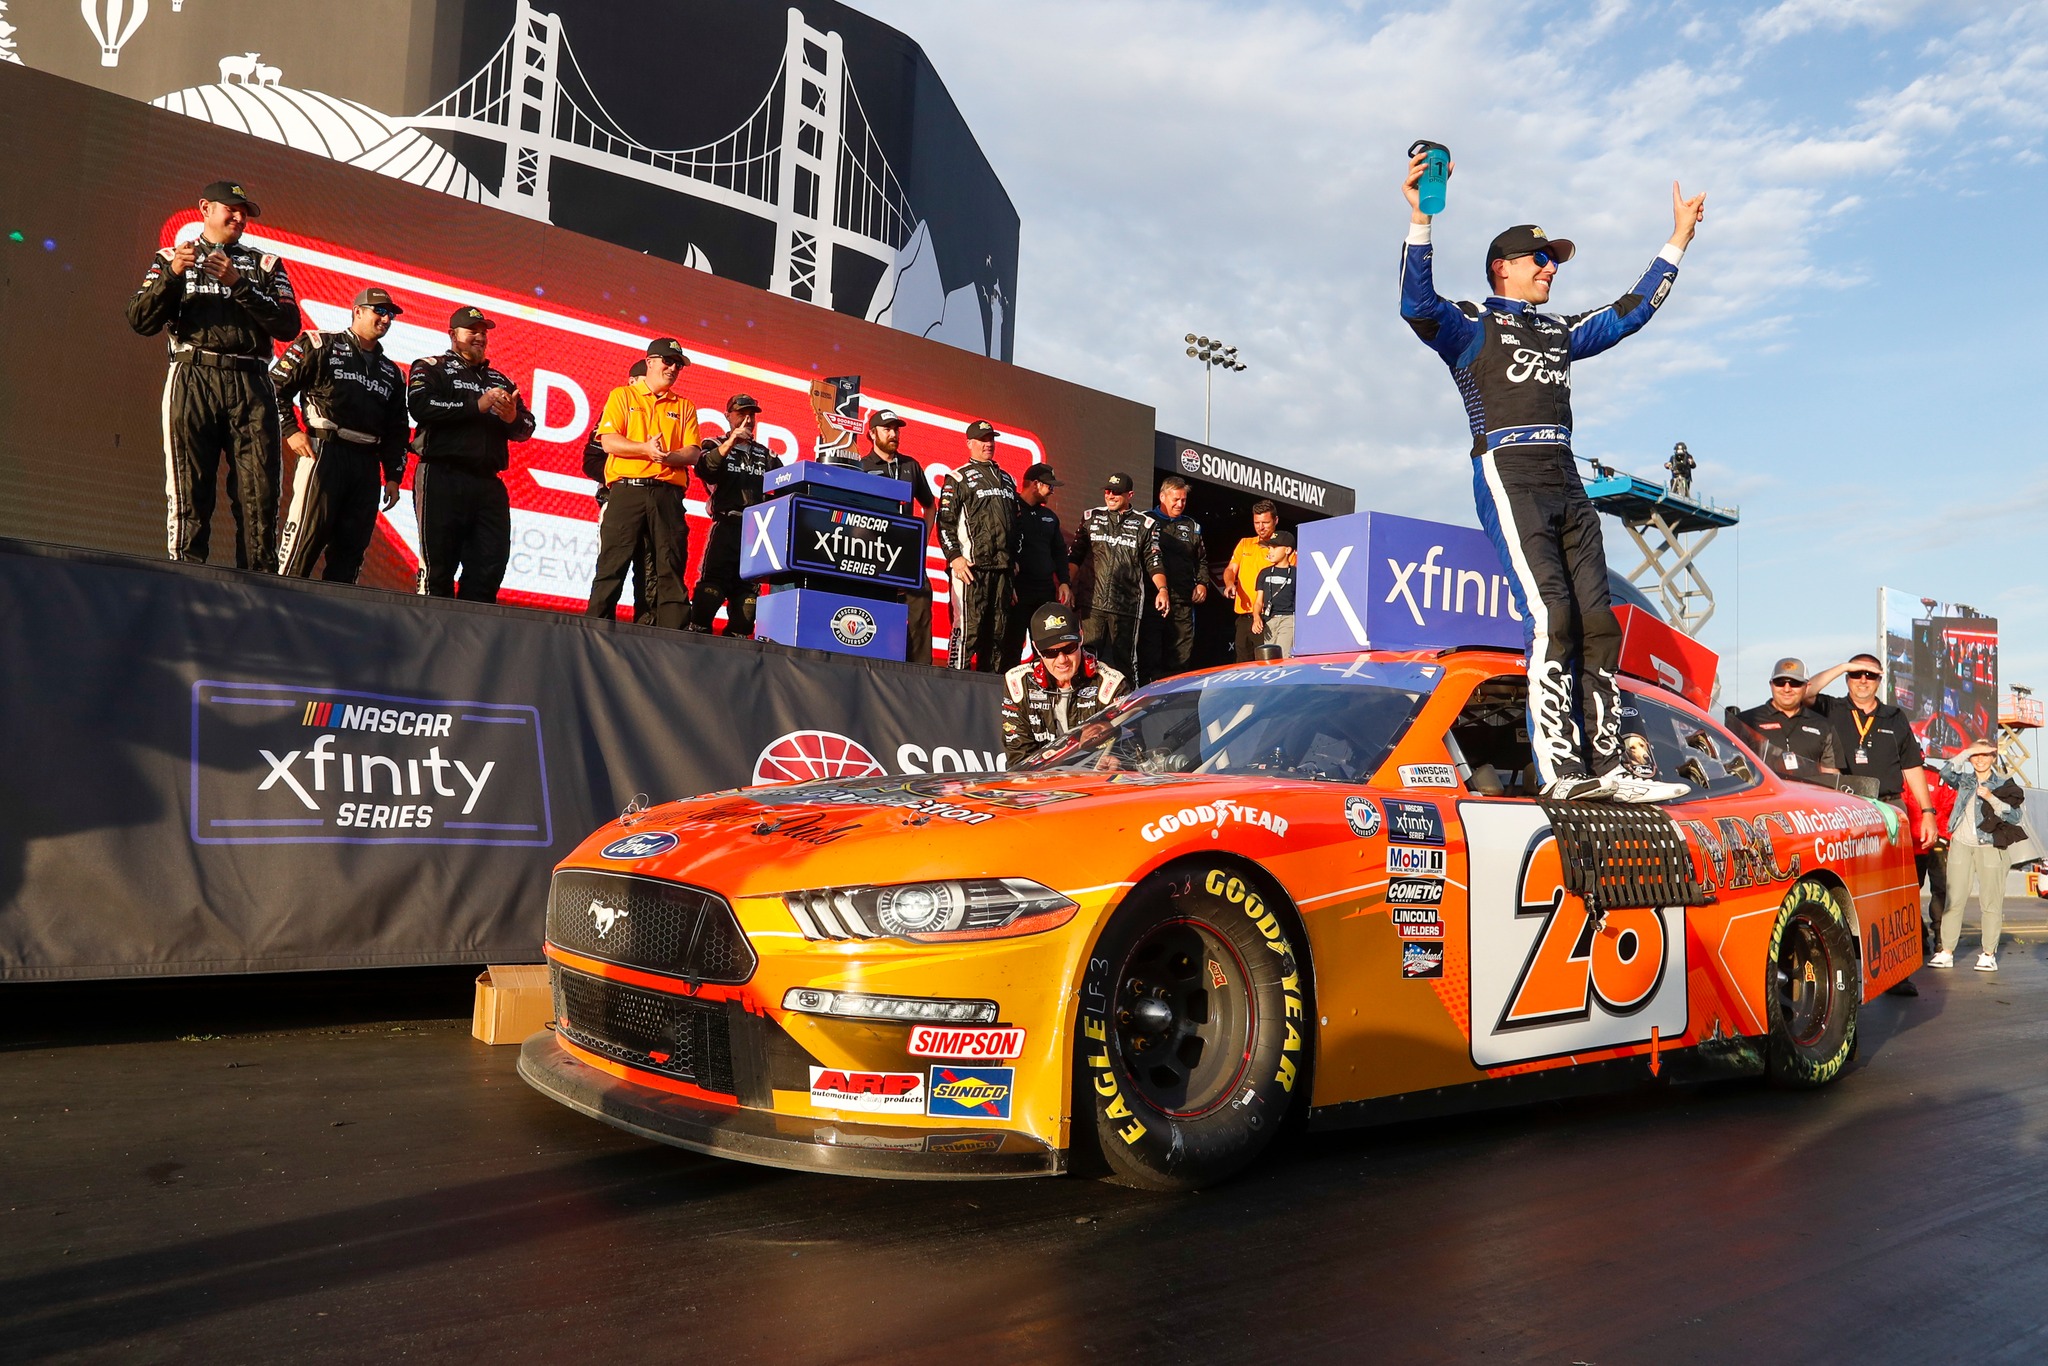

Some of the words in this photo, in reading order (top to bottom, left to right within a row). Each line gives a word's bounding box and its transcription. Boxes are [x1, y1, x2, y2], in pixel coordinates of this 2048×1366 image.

[774, 472, 792, 486] xfinity
[1201, 454, 1262, 490] SONOMA
[1264, 470, 1326, 507] RACEWAY
[845, 512, 889, 533] NASCAR
[813, 526, 903, 572] xfinity
[1090, 532, 1137, 548] Smithfield
[839, 559, 876, 576] SERIES
[1384, 544, 1525, 627] xfinit
[837, 608, 858, 619] NASCAR
[835, 629, 871, 645] ANNIVERSARY
[1192, 668, 1303, 688] xfinity
[341, 704, 453, 738] NASCAR
[257, 734, 496, 814] xfinity
[1410, 776, 1433, 784] RACE
[1436, 776, 1451, 784] CAR
[1417, 766, 1449, 776] NASCAR
[335, 802, 434, 829] SERIES
[1404, 804, 1425, 813] NASCAR
[1788, 806, 1849, 835] Michael
[1847, 801, 1883, 833] Roberts
[1395, 812, 1434, 836] xfinity
[608, 834, 666, 858] Ford
[1408, 831, 1425, 840] SERIES
[1389, 847, 1427, 869] Mobil
[1680, 811, 1801, 893] MRC
[1814, 831, 1880, 864] Construction
[1168, 874, 1192, 899] 28
[1388, 883, 1442, 900] COMETIC
[1394, 910, 1436, 923] LINCOLN
[1881, 902, 1916, 947] LARGO
[1403, 925, 1440, 936] WELDERS
[1404, 948, 1443, 962] Arrowhead
[1882, 935, 1918, 973] CONCRETE
[915, 1029, 1018, 1056] SIMPSON
[812, 1070, 921, 1096] ARP
[1083, 1014, 1148, 1146] EAGLE
[811, 1090, 859, 1102] automotive
[884, 1095, 924, 1104] products
[936, 1084, 1007, 1099] SUNOCO
